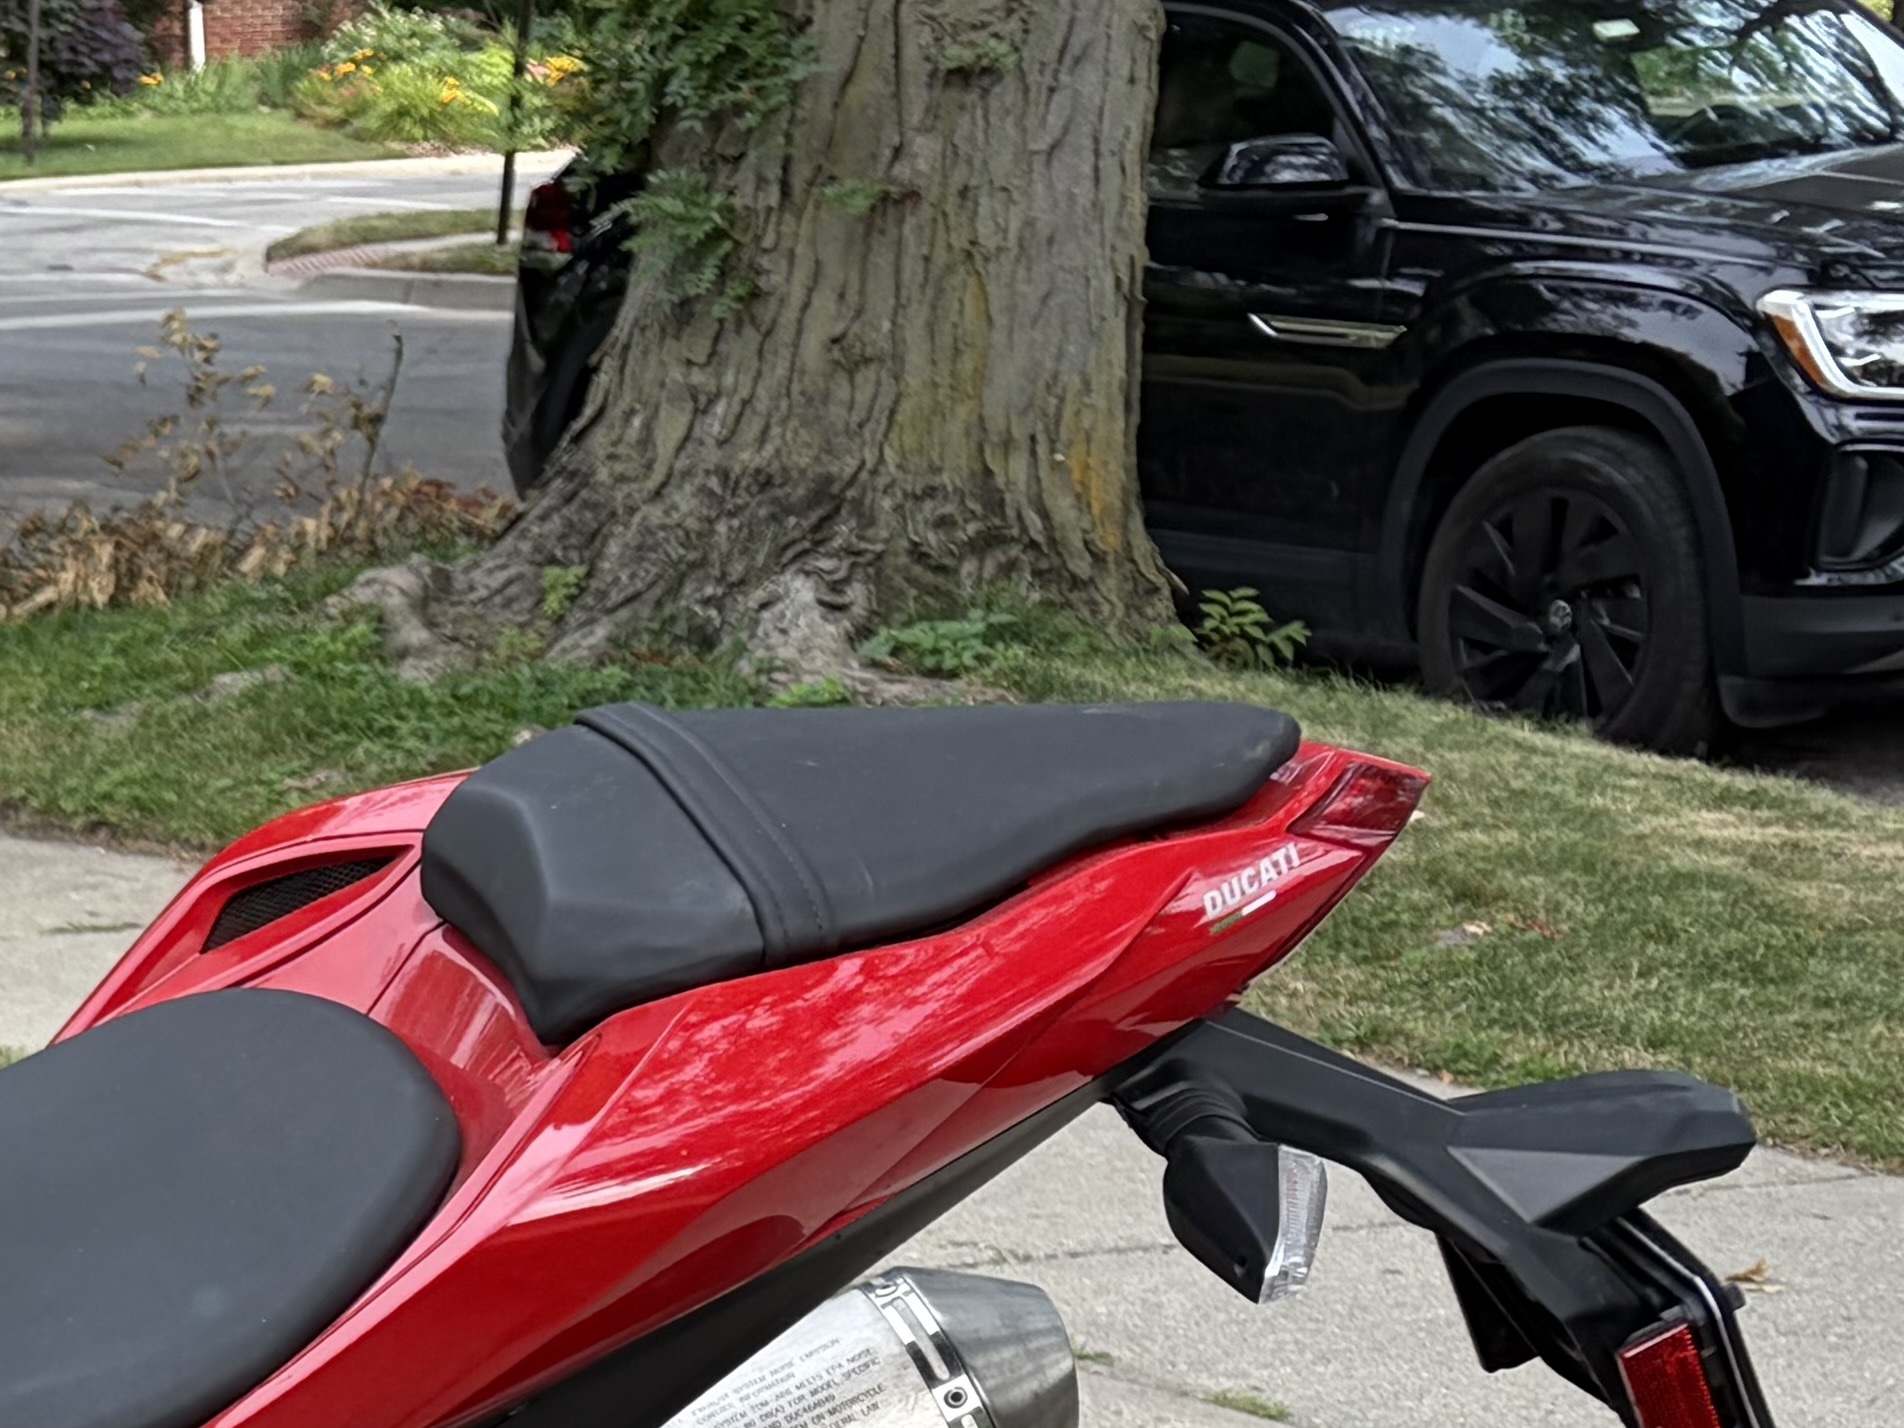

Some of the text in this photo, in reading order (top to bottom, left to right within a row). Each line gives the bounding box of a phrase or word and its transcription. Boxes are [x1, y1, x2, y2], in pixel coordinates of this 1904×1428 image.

[1203, 843, 1303, 918] DUCATI
[786, 1393, 807, 1409] FOR
[807, 1377, 839, 1399] MODEL
[841, 1355, 882, 1382] SPECIFIC
[809, 1411, 827, 1426] ON
[826, 1381, 887, 1419] MOTORCYCLE
[859, 1400, 881, 1417] LAW
